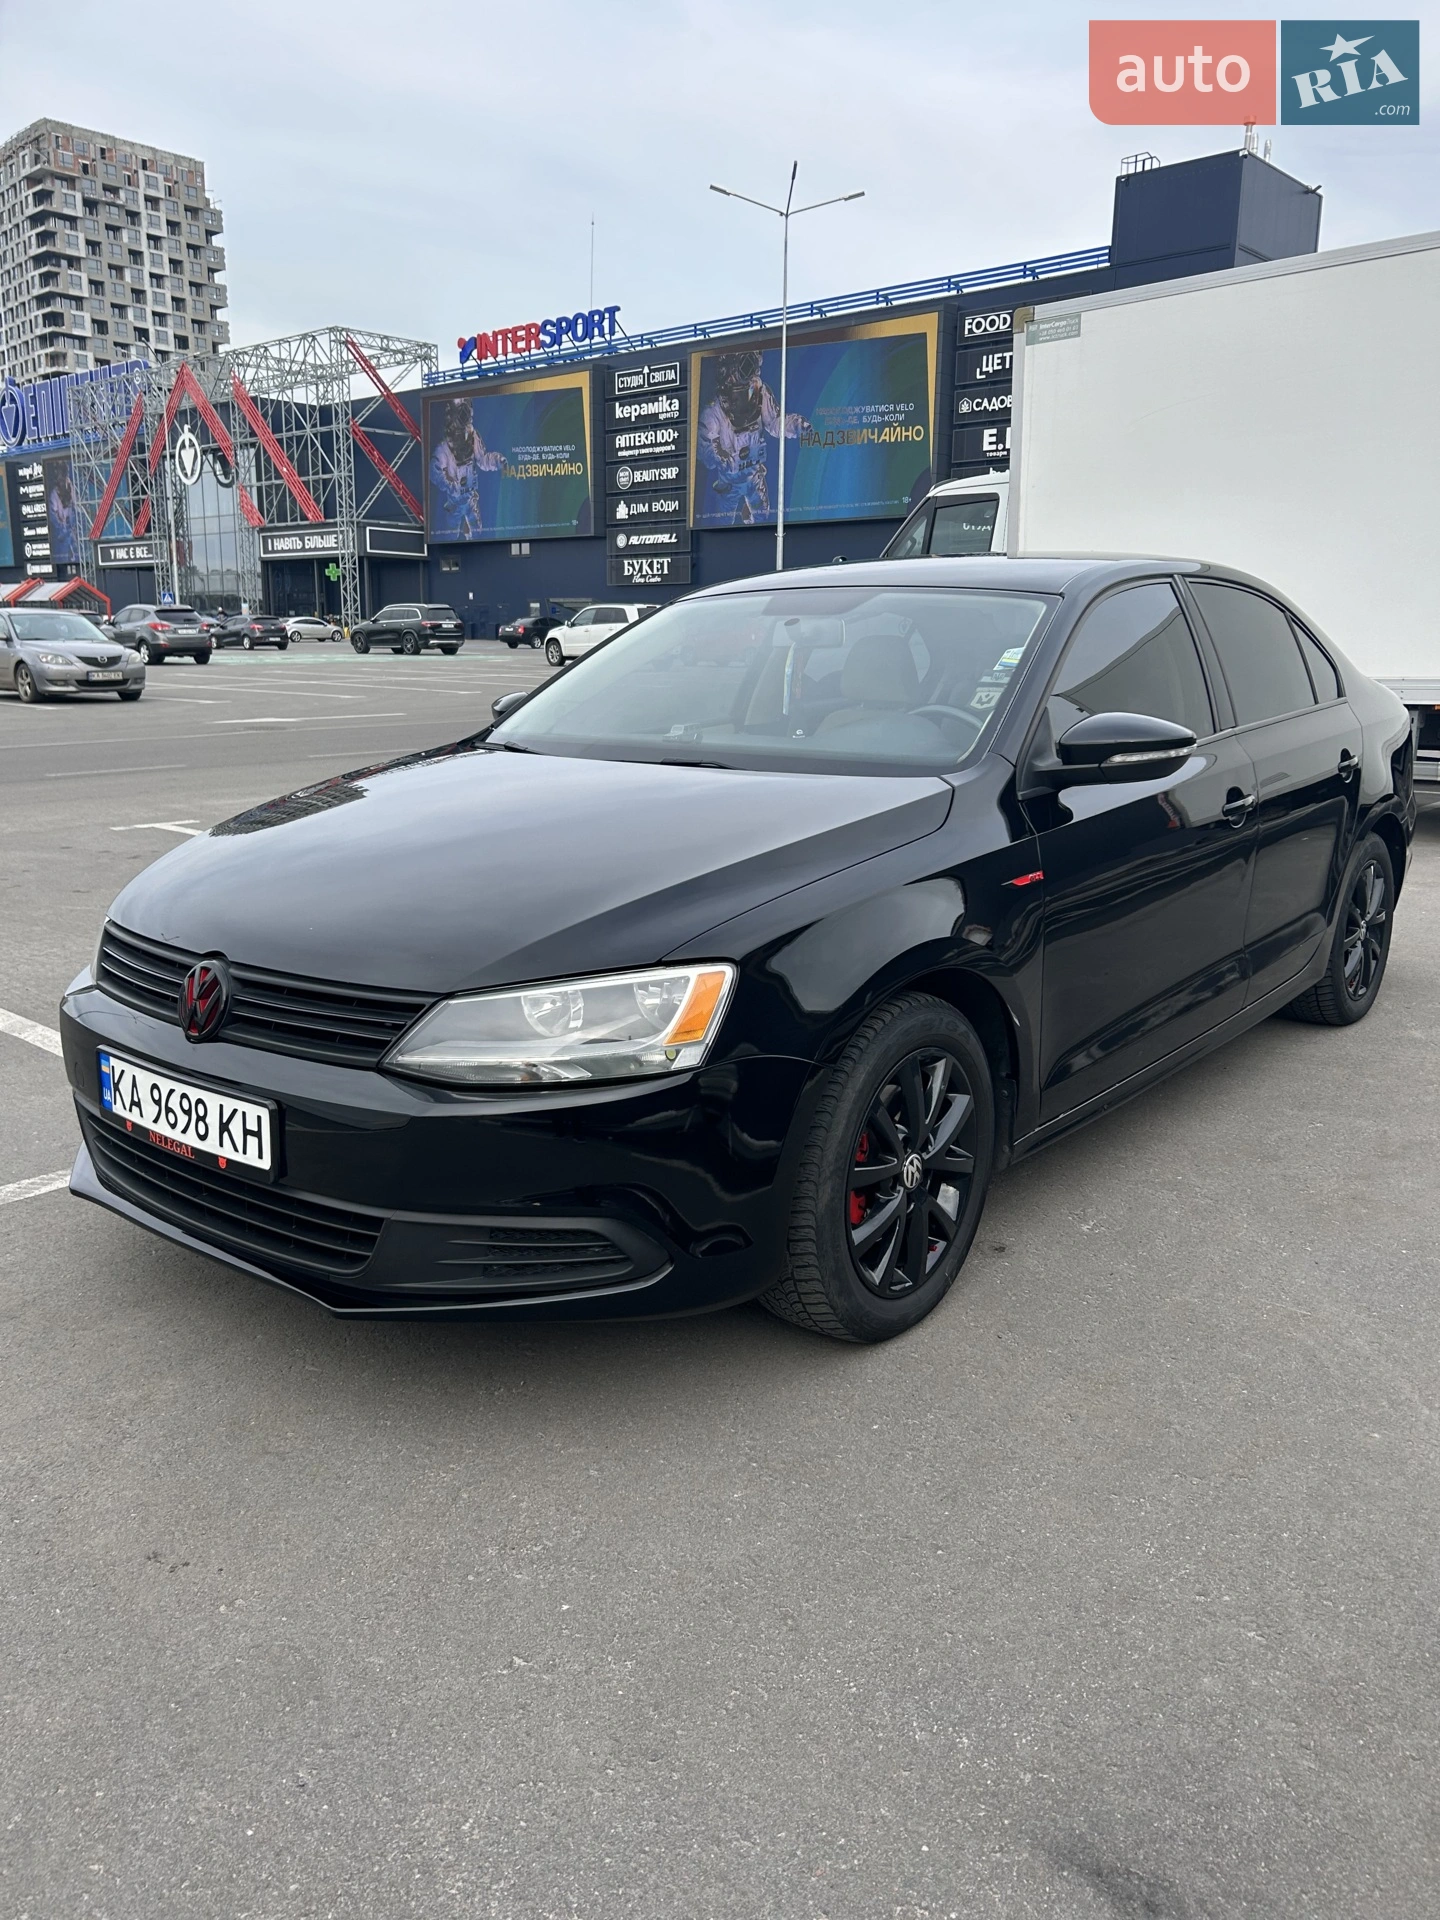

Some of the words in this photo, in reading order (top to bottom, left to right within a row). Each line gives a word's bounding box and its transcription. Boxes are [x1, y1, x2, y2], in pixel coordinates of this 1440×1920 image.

[476, 305, 621, 361] INTERSPORT
[964, 313, 1012, 335] FOOD
[618, 374, 644, 389] СТУДІЯ
[649, 369, 676, 384] СВІТЛА
[658, 411, 680, 421] центр
[895, 402, 915, 412] VELO
[615, 431, 656, 449] АПТЕКА
[800, 422, 925, 449] НАДЗВИЧАЙНО
[563, 444, 576, 452] VELO
[502, 459, 584, 480] НАДЗВИЧАЙНО
[633, 468, 660, 483] BEAUTY
[660, 466, 680, 480] SHOP
[630, 502, 649, 516] ДІМ
[652, 499, 679, 513] ВОДИ
[273, 536, 303, 551] НАВІТЬ
[628, 533, 678, 545] AUTOMALL
[623, 558, 671, 578] БУКЕТ
[103, 1087, 112, 1103] UA
[111, 1065, 144, 1119] KA
[150, 1082, 209, 1142] 9698
[218, 1103, 263, 1160] KH
[148, 1130, 195, 1159] NELEGAL
